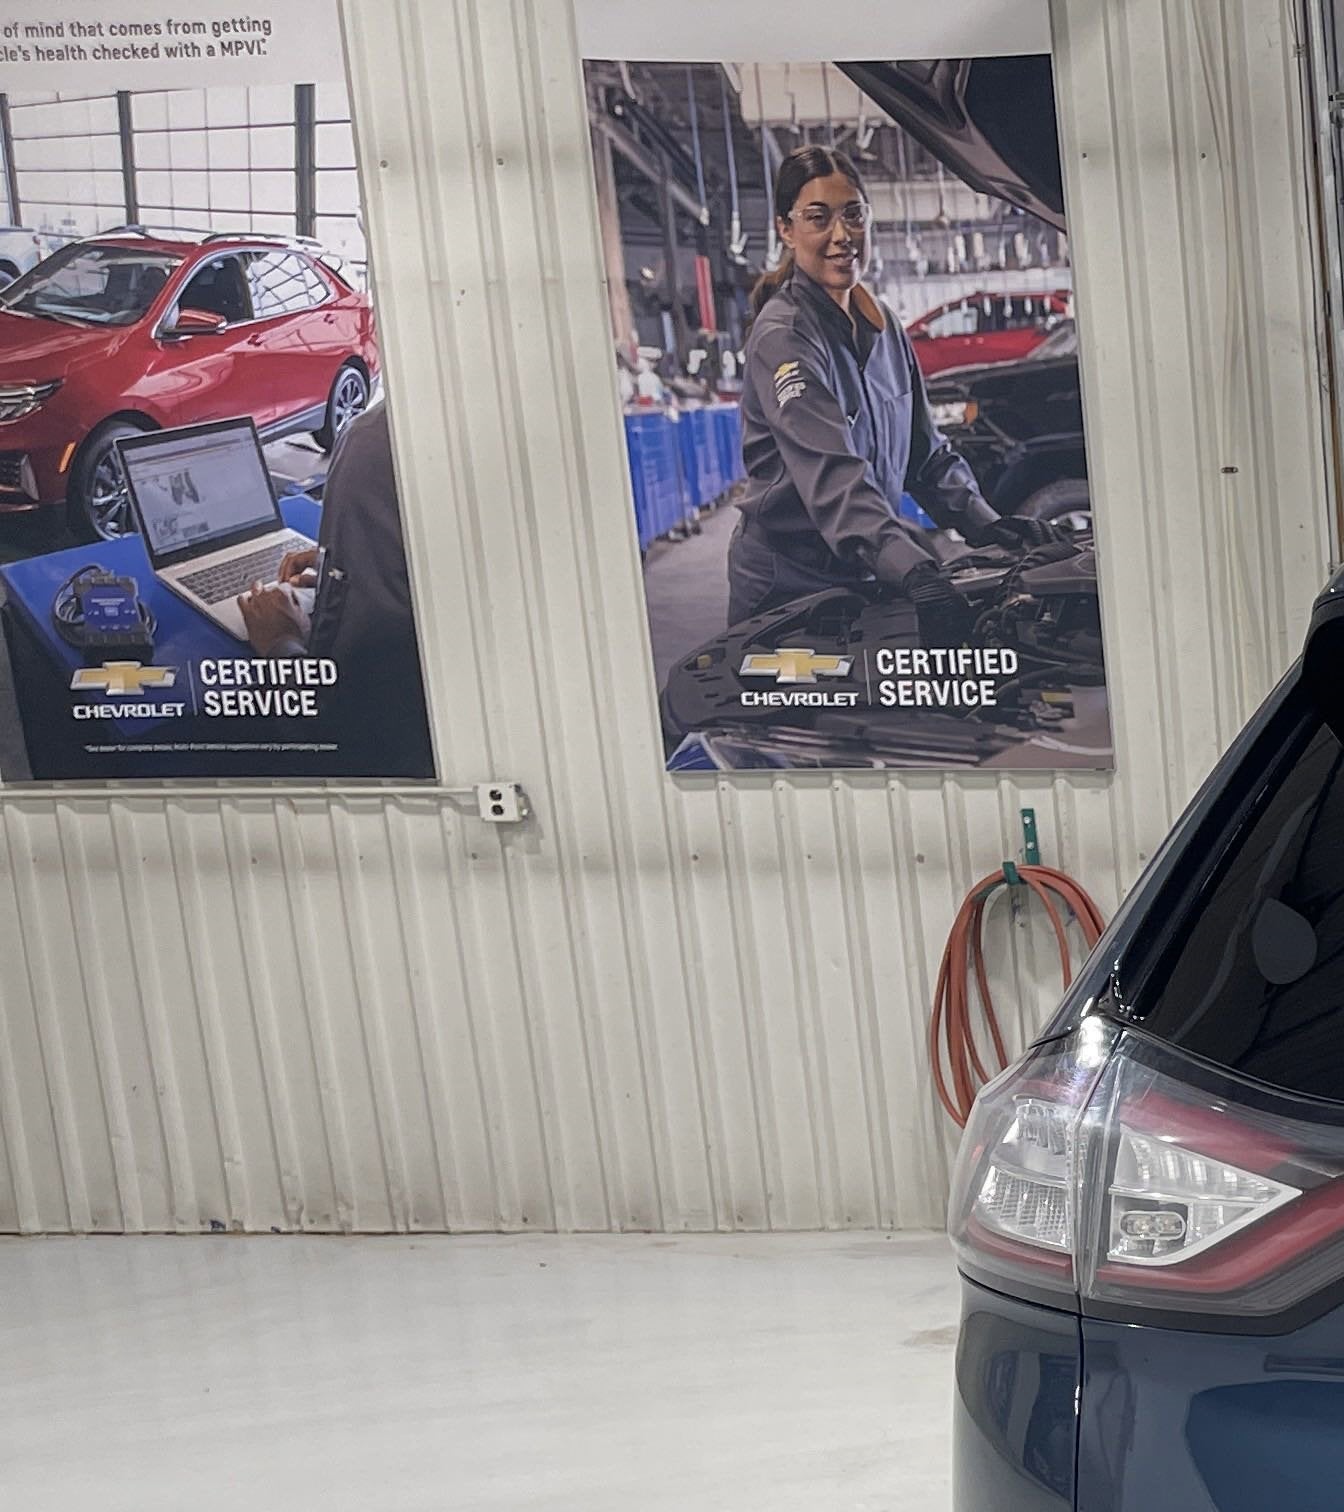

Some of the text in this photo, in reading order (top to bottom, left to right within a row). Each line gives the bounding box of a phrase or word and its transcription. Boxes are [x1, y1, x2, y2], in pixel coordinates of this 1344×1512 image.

[4, 16, 272, 38] of mind that comes from getting
[36, 44, 87, 61] health
[92, 43, 160, 60] checked
[165, 41, 202, 58] with
[206, 46, 216, 57] a
[199, 658, 338, 686] CERTIFIED
[876, 648, 1018, 675] CERTIFIED
[203, 690, 318, 716] SERVICE
[741, 692, 859, 707] CHEVROLET
[879, 680, 997, 706] SERVICE
[72, 702, 185, 720] CHEVROLET
